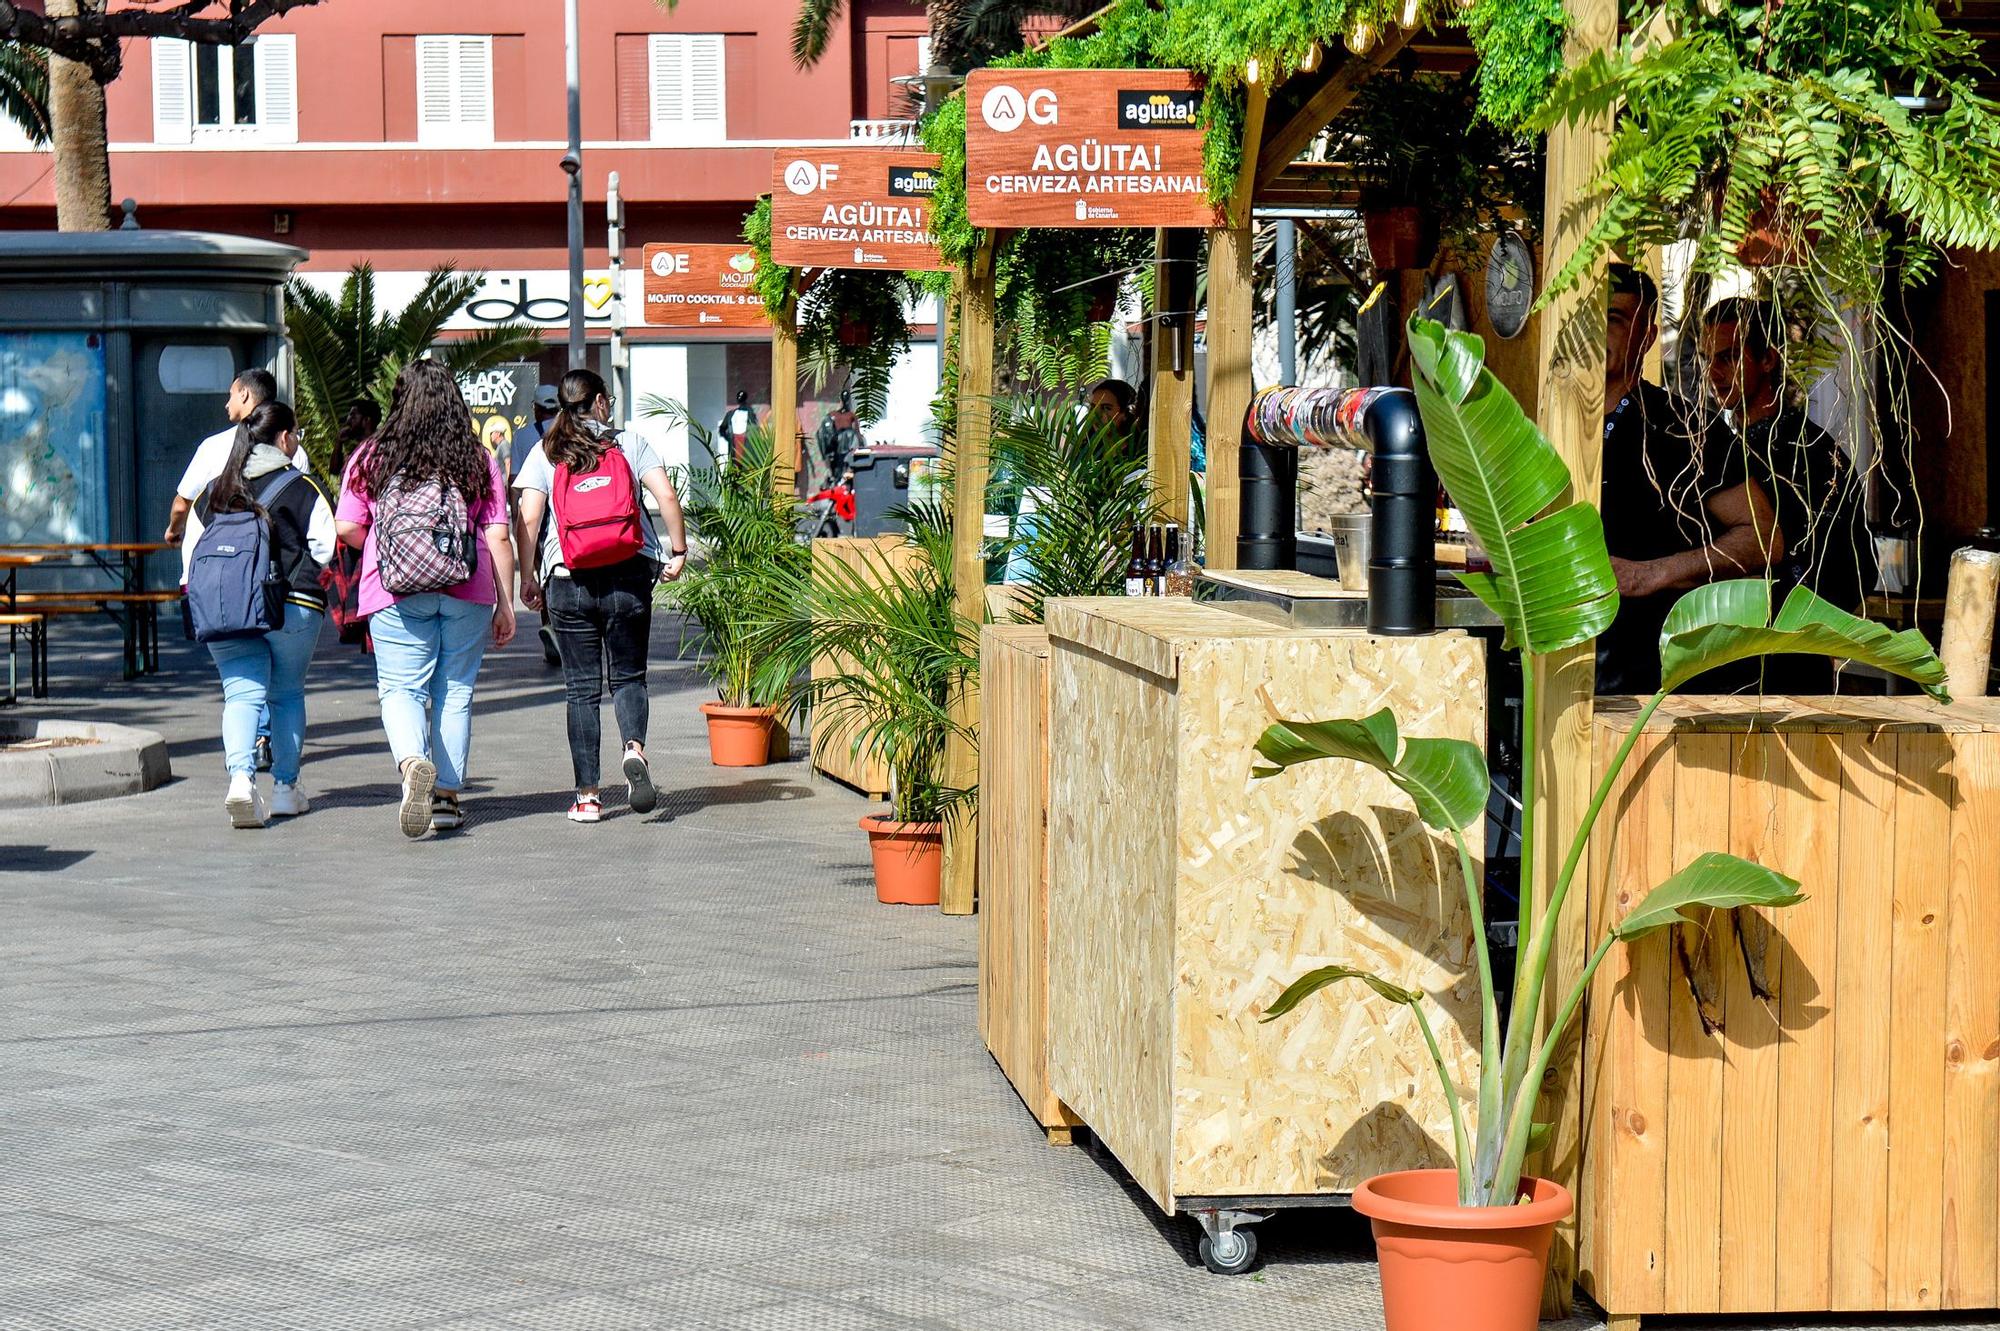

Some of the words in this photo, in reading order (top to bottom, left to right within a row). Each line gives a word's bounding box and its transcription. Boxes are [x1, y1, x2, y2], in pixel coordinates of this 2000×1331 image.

[1031, 138, 1161, 172] AGÜITA!
[985, 175, 1081, 193] CERVEZA
[1085, 176, 1207, 193] ARTESANAL
[821, 201, 922, 227] AGÜITA!
[785, 225, 860, 242] CERVEZA
[647, 293, 685, 304] MOJITO
